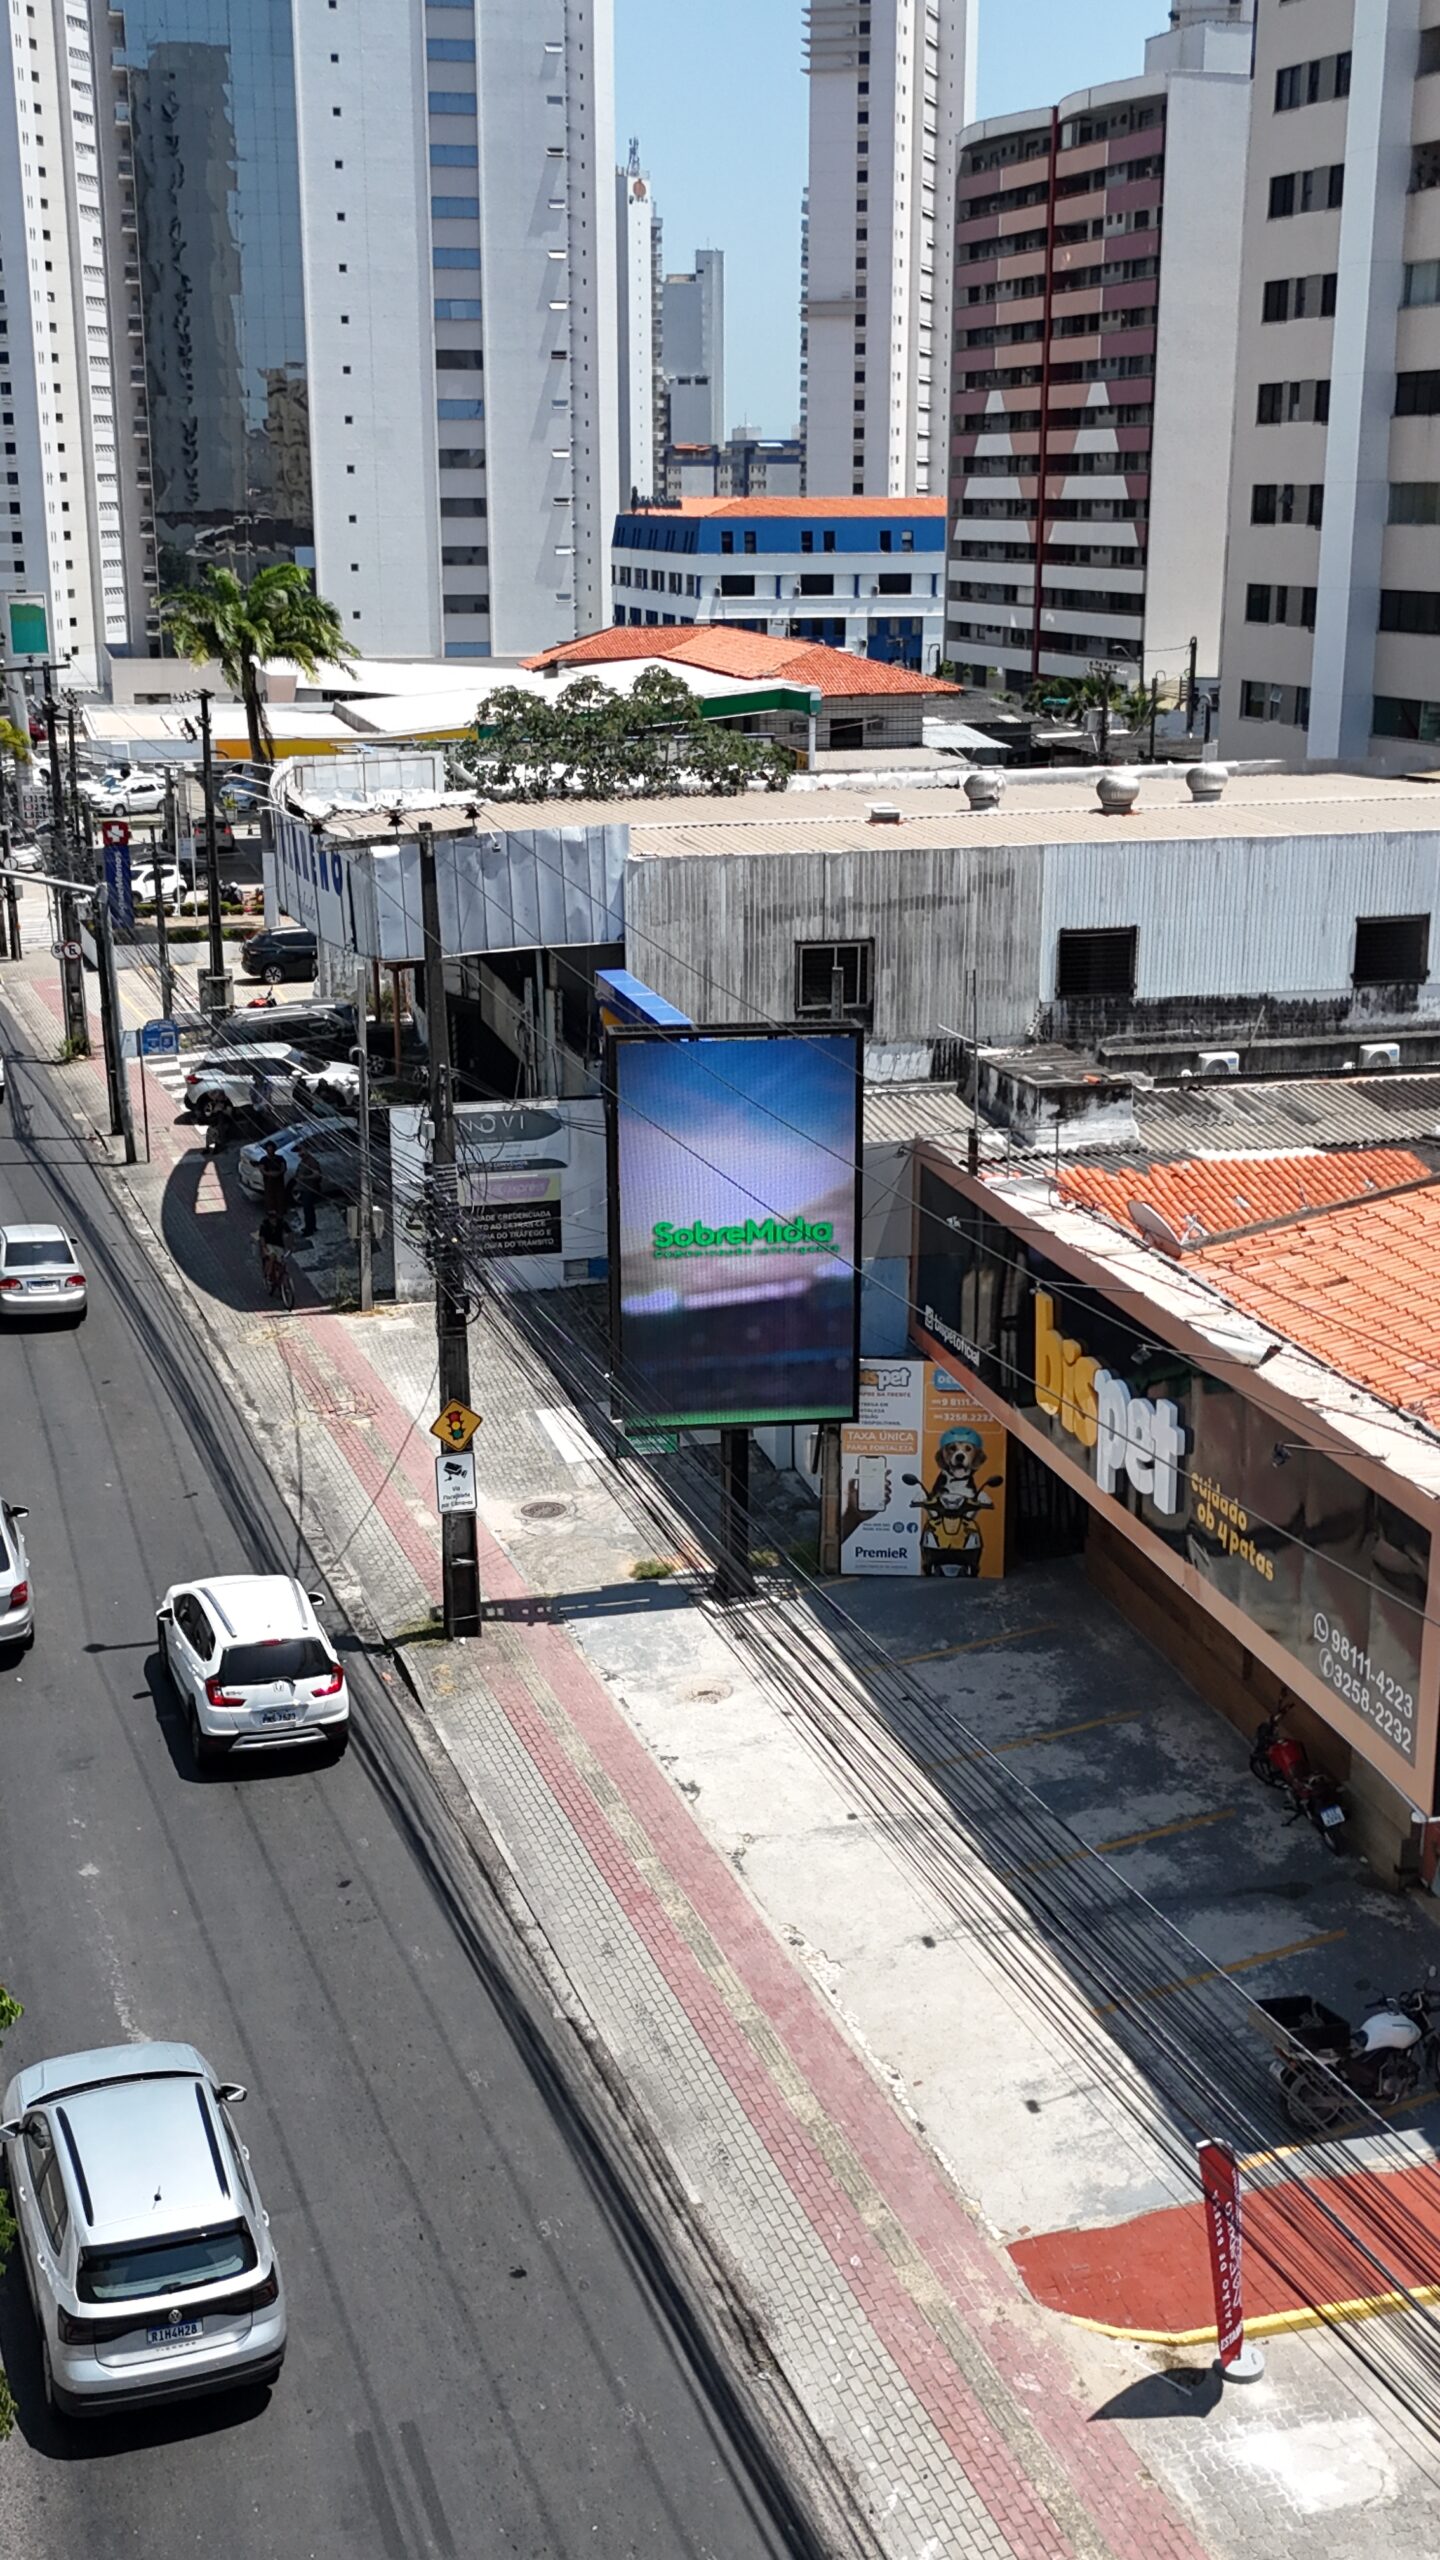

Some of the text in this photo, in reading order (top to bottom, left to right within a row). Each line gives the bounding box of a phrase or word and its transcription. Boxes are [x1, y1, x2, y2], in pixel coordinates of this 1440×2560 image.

[847, 1430, 913, 1441] TAXA ÚNICA
[1034, 1290, 1186, 1515] bispet
[1191, 1472, 1248, 1531] cuidado
[1229, 1530, 1274, 1582] patas
[1331, 1629, 1413, 1719] 98111-4223
[1333, 1664, 1412, 1754] 3258-2232
